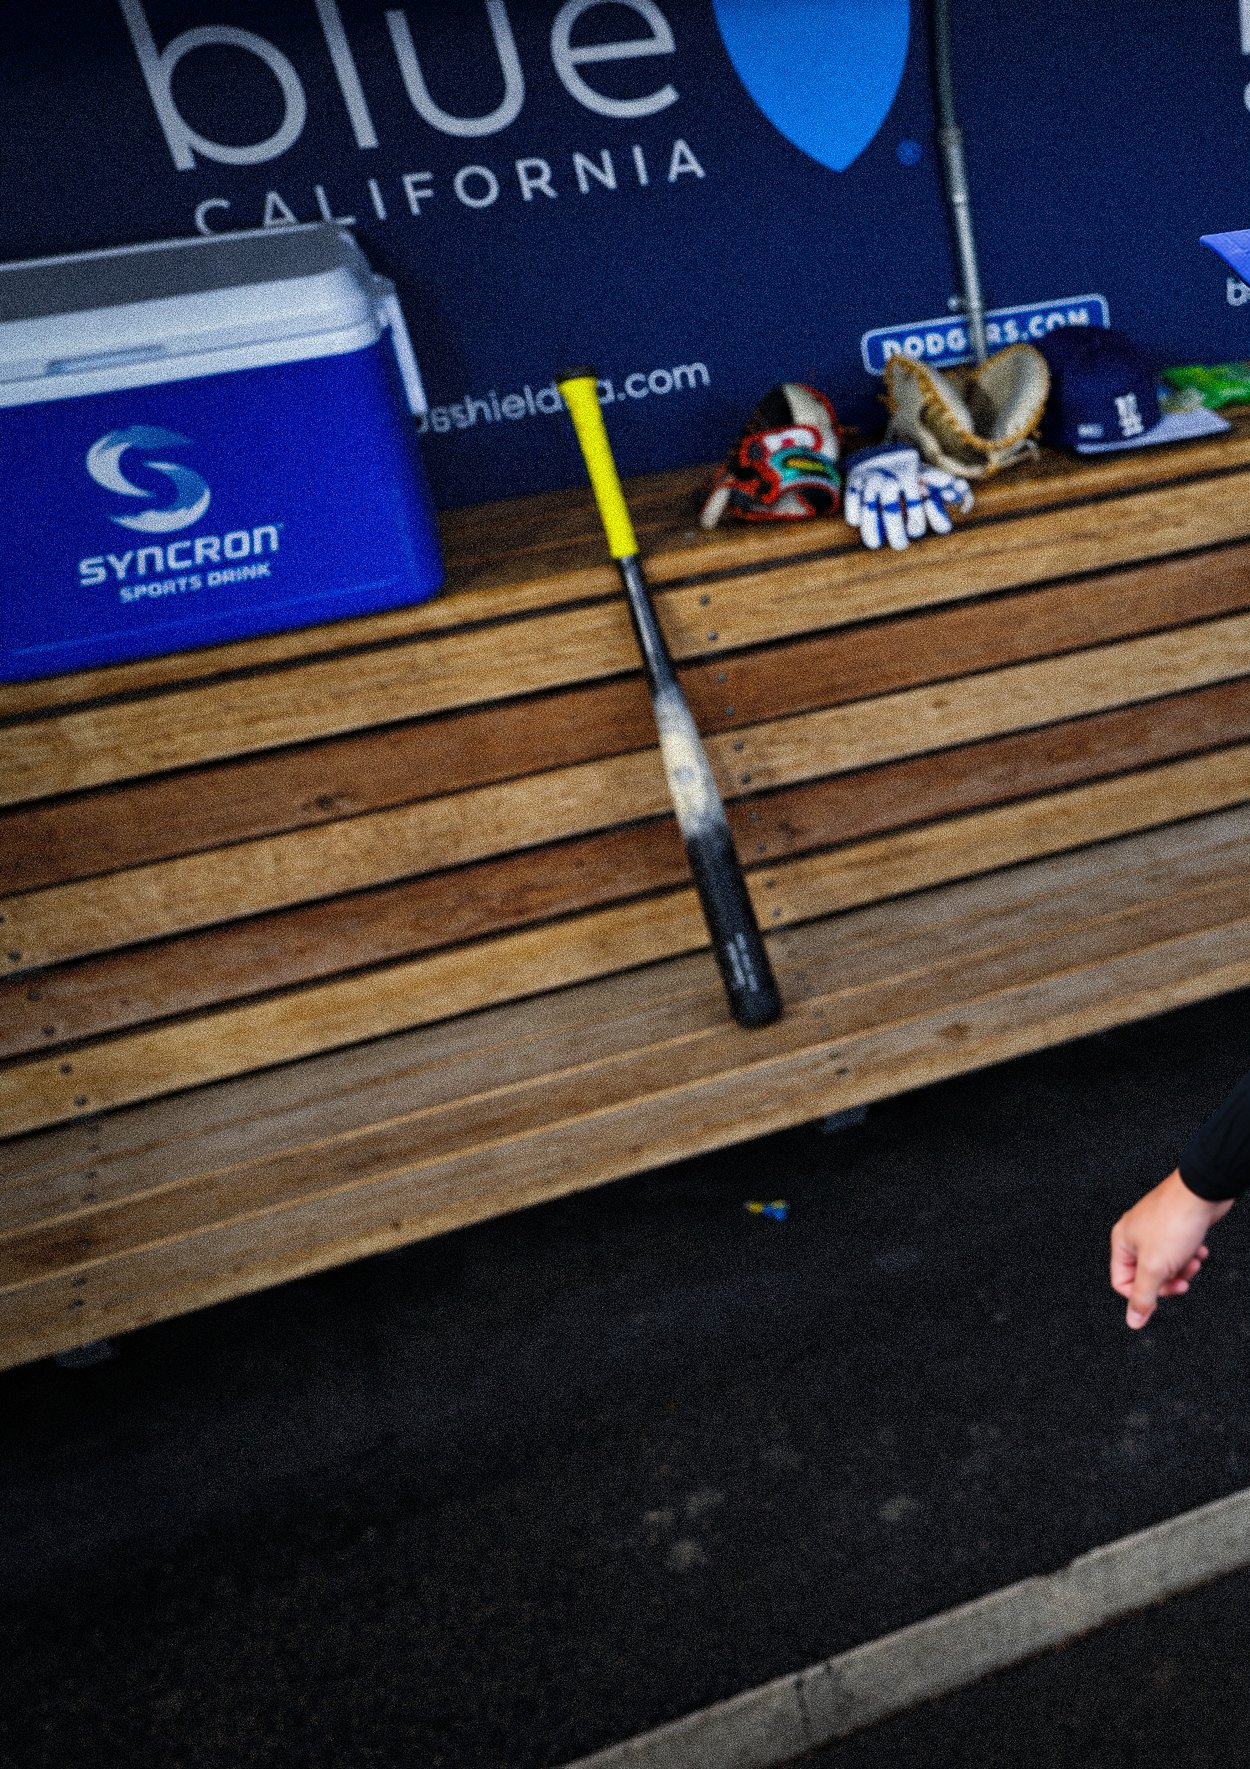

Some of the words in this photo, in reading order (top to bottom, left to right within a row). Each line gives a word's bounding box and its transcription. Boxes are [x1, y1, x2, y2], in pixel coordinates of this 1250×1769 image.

[193, 139, 705, 237] CALIFORNIA
[882, 308, 1090, 361] DODGRS.COM
[120, 574, 202, 603] SPORTS
[207, 561, 271, 588] DRINK
